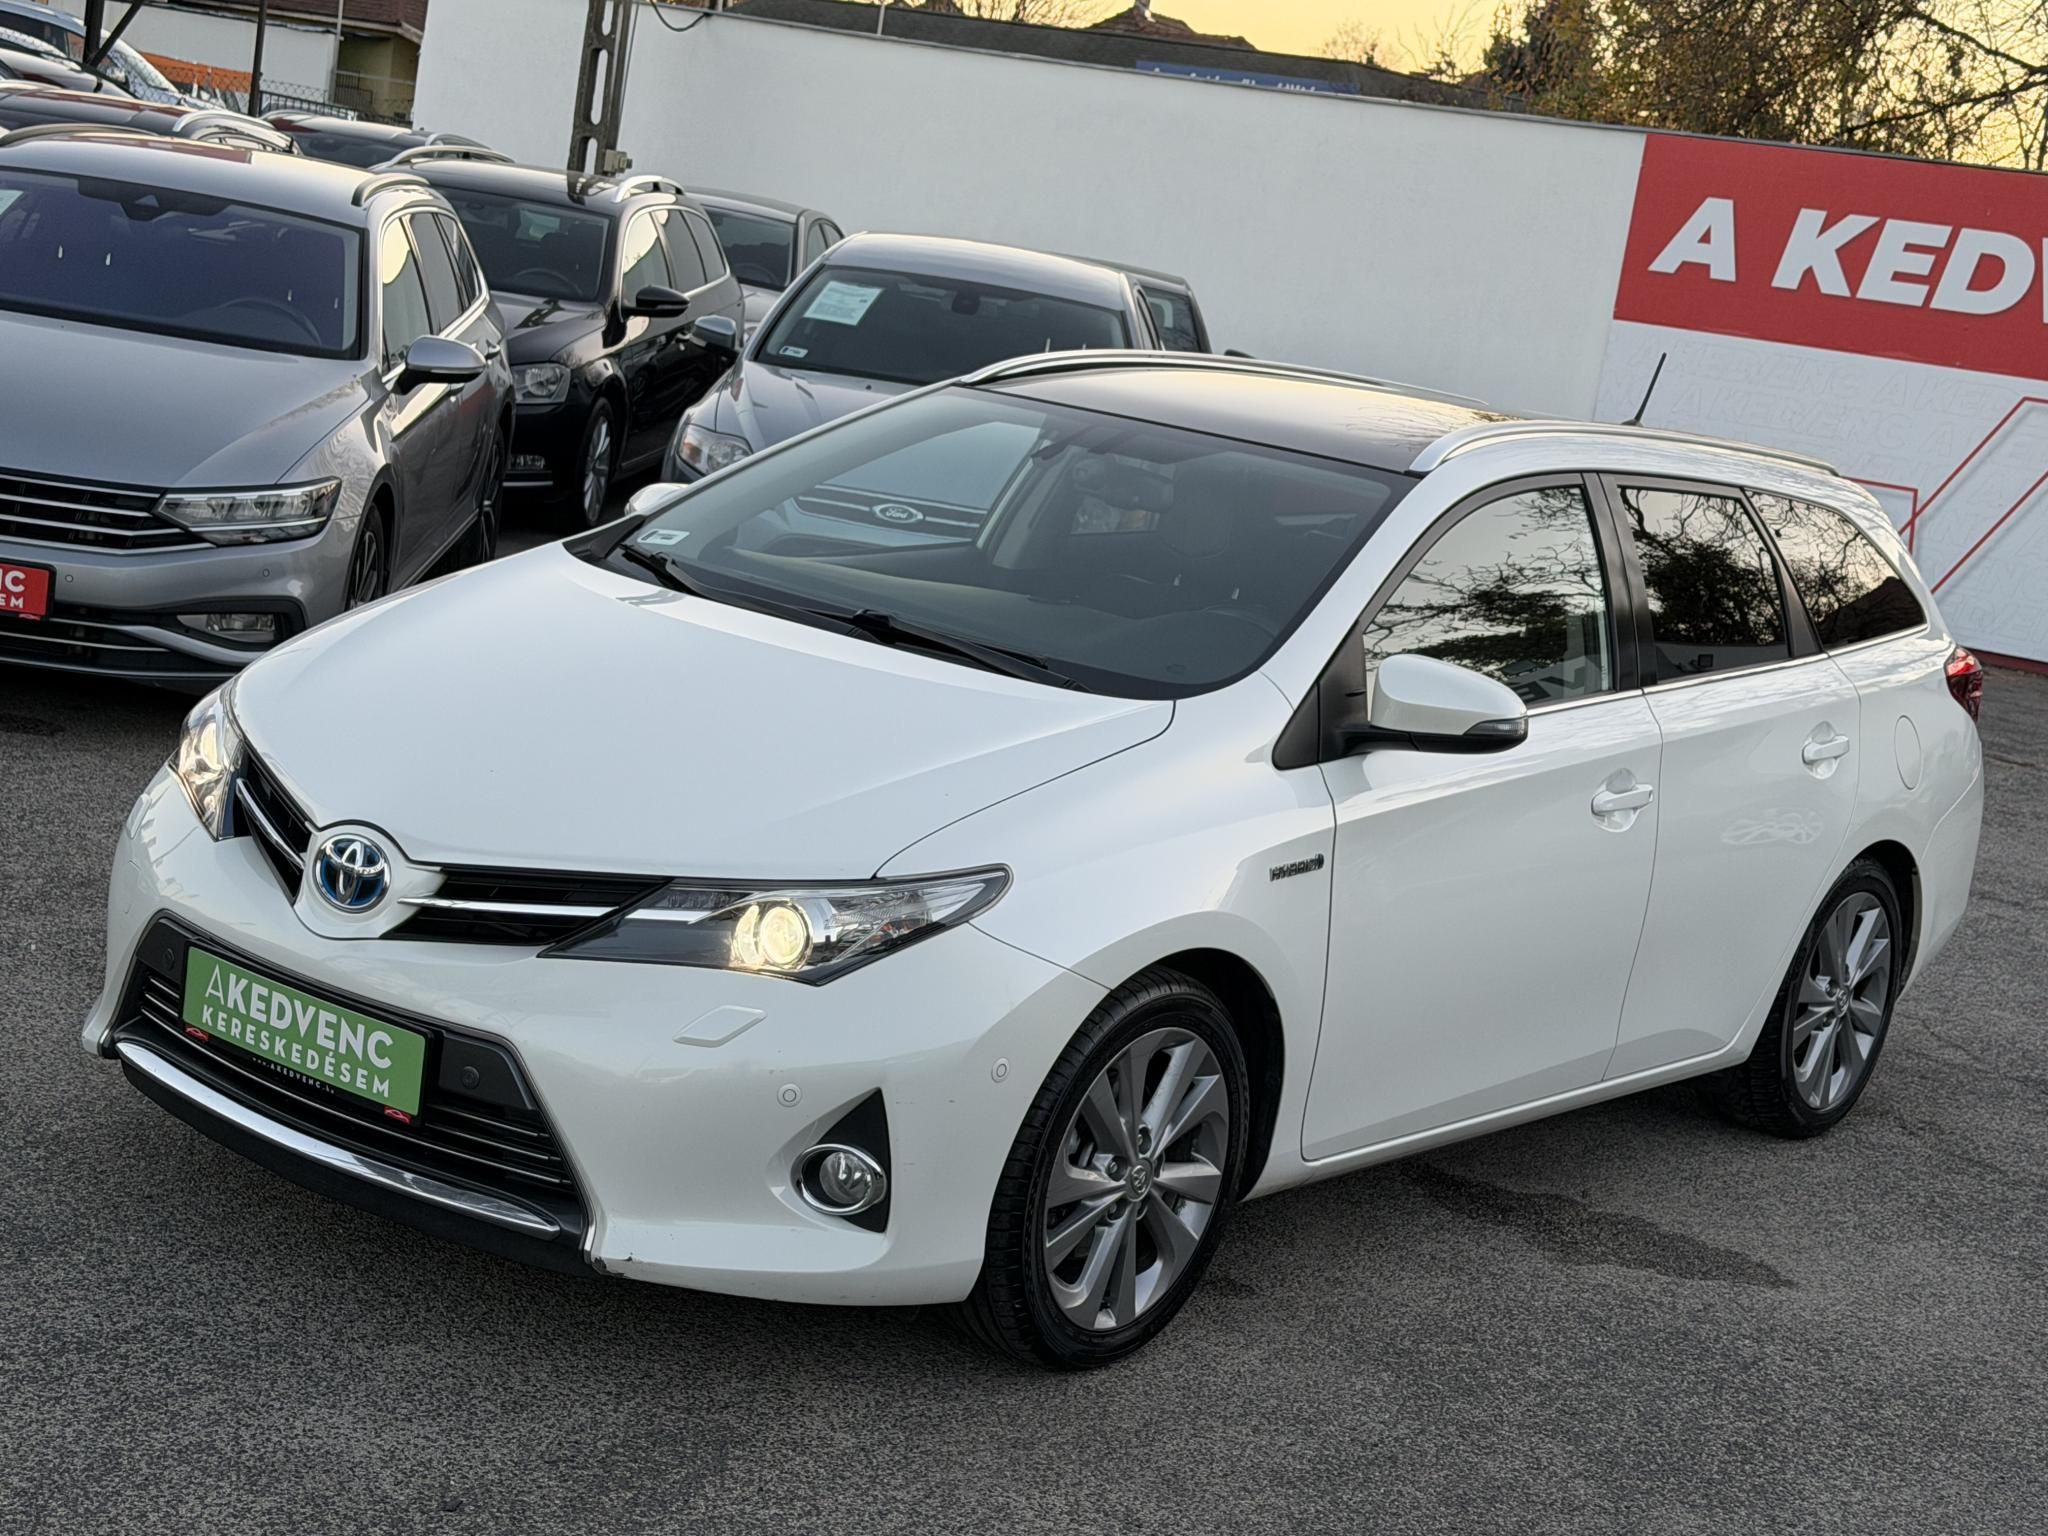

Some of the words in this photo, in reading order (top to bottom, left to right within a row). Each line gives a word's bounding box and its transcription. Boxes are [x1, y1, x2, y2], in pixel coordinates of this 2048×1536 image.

[1648, 197, 1736, 282] A
[1771, 208, 2048, 324] KED
[0, 569, 26, 592] C
[202, 1004, 390, 1098] KERESKEDÉSEM
